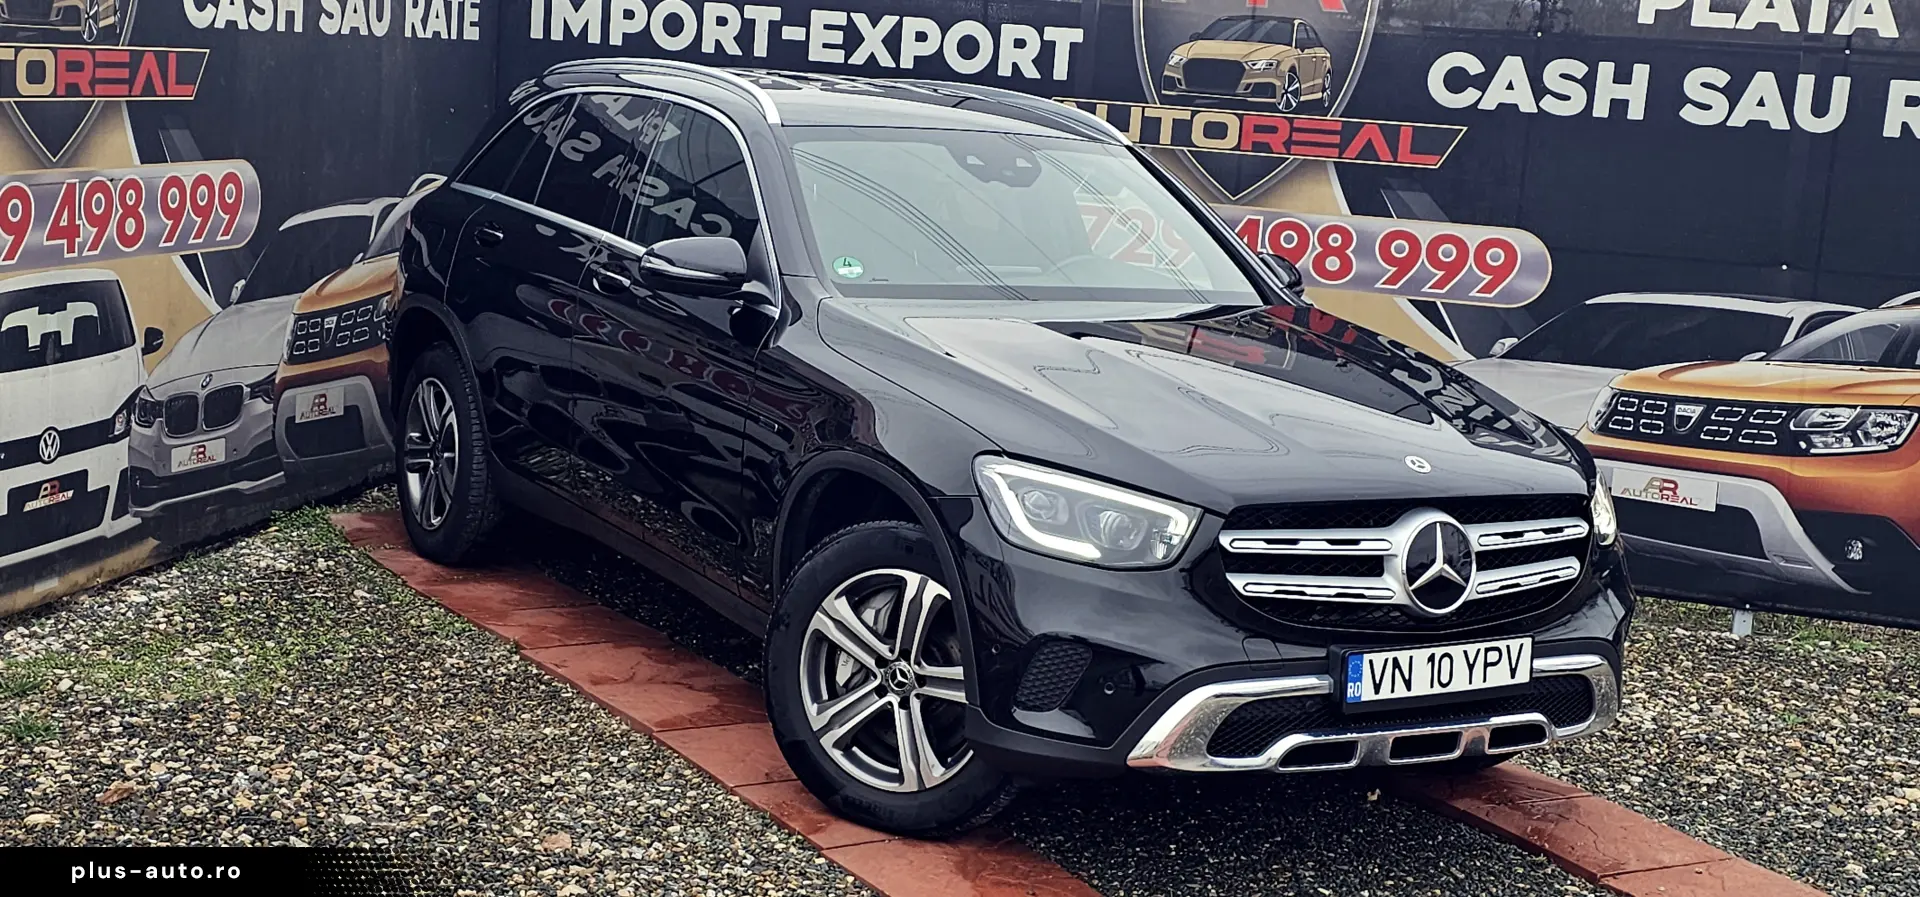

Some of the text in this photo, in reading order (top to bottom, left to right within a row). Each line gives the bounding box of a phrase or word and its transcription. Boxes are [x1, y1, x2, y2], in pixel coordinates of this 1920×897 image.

[181, 0, 480, 40] CASH SAU RATE
[530, 0, 1084, 81] IMPORT-EXPORT
[1427, 51, 1650, 120] CASH
[1679, 66, 1851, 133] SAU
[1063, 101, 1443, 164] UTOREAL
[43, 176, 146, 258] 498
[158, 168, 244, 247] 999
[1374, 227, 1522, 298] 999
[1621, 488, 1698, 506] AUTOREAL
[1347, 643, 1524, 699] RO VN 10 YPV
